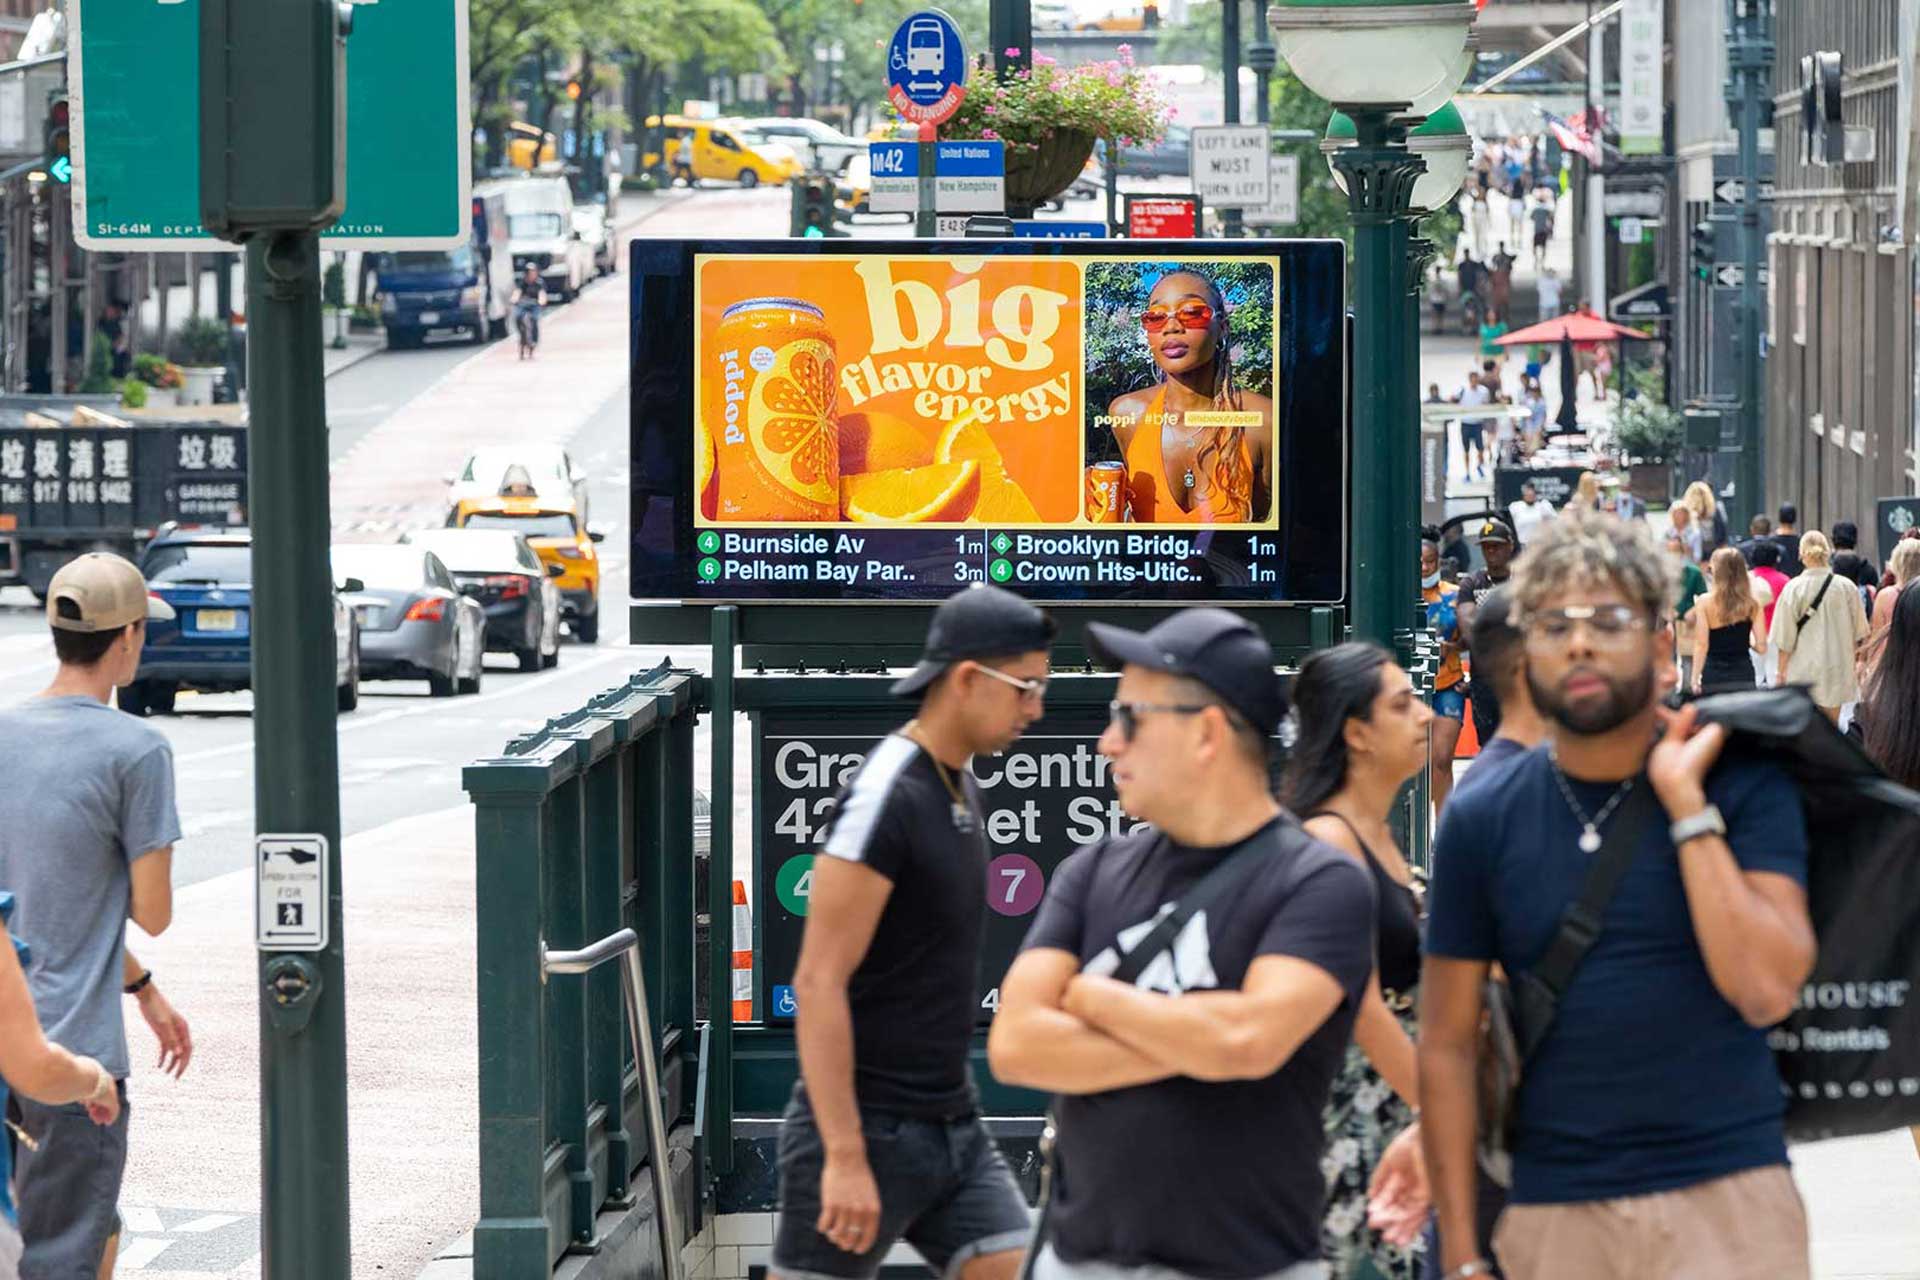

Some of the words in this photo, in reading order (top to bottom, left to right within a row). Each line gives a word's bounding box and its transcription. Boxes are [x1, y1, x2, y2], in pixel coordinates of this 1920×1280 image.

[894, 92, 908, 111] NO
[909, 90, 958, 120] STANDING
[940, 147, 961, 159] United
[964, 147, 990, 159] Nations
[1198, 135, 1225, 150] LEFT
[1232, 135, 1265, 150] LANE
[872, 148, 904, 173] M42
[1211, 157, 1250, 173] MUST
[939, 181, 955, 192] New
[1199, 183, 1229, 196] TURN
[1235, 181, 1265, 196] LEFT
[1133, 204, 1145, 215] NO
[1146, 204, 1185, 215] STANDING
[98, 223, 151, 234] SI-64M
[940, 220, 945, 231] E
[948, 220, 957, 231] 42
[853, 257, 1069, 371] big
[840, 354, 993, 407] flavor
[719, 349, 745, 446] poppi
[913, 371, 1071, 424] energy
[1093, 412, 1136, 428] poppi
[1144, 413, 1179, 426] #bfe
[1484, 522, 1494, 535] P
[705, 537, 714, 548] 4
[724, 533, 828, 554] Burnside
[834, 535, 865, 554] Av
[954, 535, 984, 554] 1m
[998, 538, 1006, 549] 6
[1016, 534, 1120, 560] Brooklyn
[1127, 535, 1203, 560] Bridg..
[1247, 536, 1276, 555] 1m
[705, 563, 714, 574] 6
[724, 560, 809, 580] Pelham
[816, 560, 860, 585] Bay
[866, 560, 916, 580] Par..
[954, 562, 984, 581] 3m
[997, 565, 1006, 576] 4
[1016, 561, 1091, 581] Crown
[1097, 561, 1203, 582] Hts-Utic..
[1247, 562, 1276, 581] 1m
[774, 740, 865, 790] Gra
[969, 743, 1114, 790] Centr
[277, 886, 302, 898] FOR
[793, 868, 812, 902] 4
[1000, 868, 1027, 903] 7
